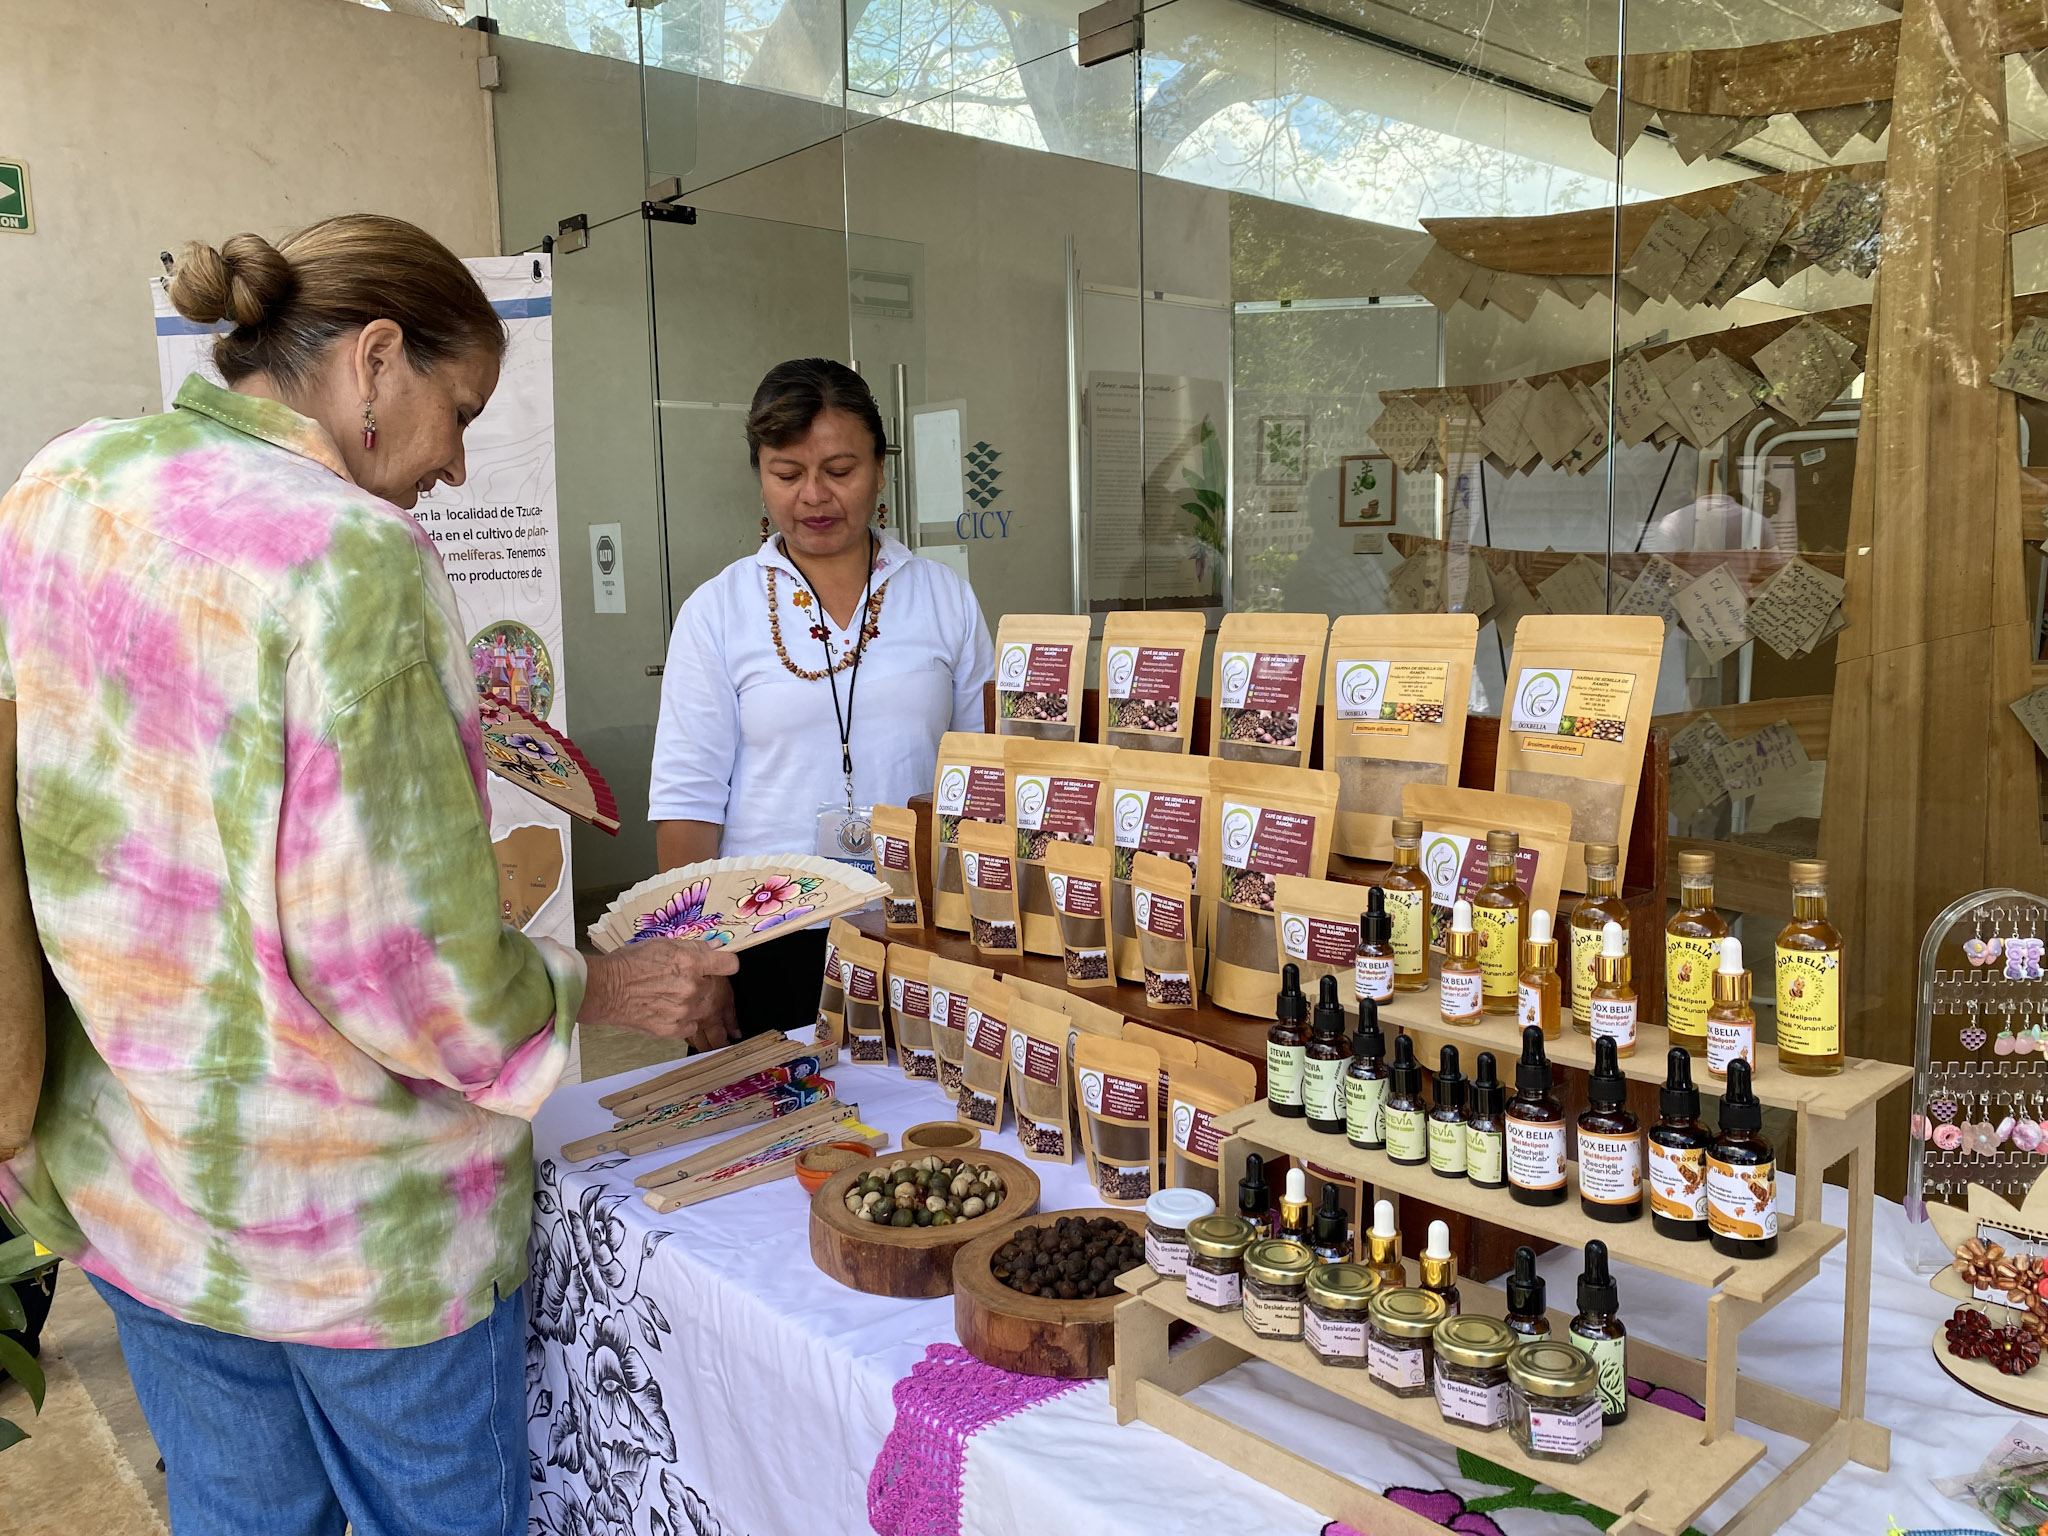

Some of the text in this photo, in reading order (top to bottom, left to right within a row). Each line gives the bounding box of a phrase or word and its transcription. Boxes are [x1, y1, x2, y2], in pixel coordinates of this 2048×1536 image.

[0, 216, 20, 228] ON
[414, 506, 542, 521] en la localidad de Tzuca-
[957, 510, 1013, 539] CICY
[429, 526, 549, 541] da en el cultivo de plan-
[449, 550, 504, 562] melíferas.
[506, 547, 546, 559] Tenemos
[447, 567, 542, 584] mo productores de
[1389, 893, 1412, 910] BELIA
[1473, 911, 1507, 928] OX BELIA
[1685, 941, 1713, 960] BELIA
[1369, 961, 1389, 969] BELIA
[1797, 955, 1827, 975] BELIA
[1441, 976, 1450, 984] OX
[1519, 986, 1529, 996] ELIA
[1678, 996, 1707, 1006] Melipona
[1592, 1001, 1632, 1014] ÓOX BELIA
[1681, 1006, 1706, 1014] "Xunan
[1790, 1013, 1822, 1022] Melipona
[1714, 1028, 1740, 1037] BELIA
[1794, 1023, 1820, 1031] "Xunan
[1270, 1047, 1291, 1058] STEVIA
[1430, 1124, 1454, 1138] TEVIA
[1508, 1123, 1554, 1140] ÓOX BELIA
[1522, 1141, 1549, 1149] Melipona
[1580, 1136, 1627, 1153] ÓOX BELIA
[1160, 1245, 1189, 1253] Deshidrata
[1188, 1269, 1218, 1285] Deshidratado
[1263, 1303, 1300, 1312] Deshidratado
[1322, 1324, 1361, 1333] Deshidratado
[1447, 1383, 1488, 1399] Deshidratado
[1557, 1418, 1577, 1426] Polen
